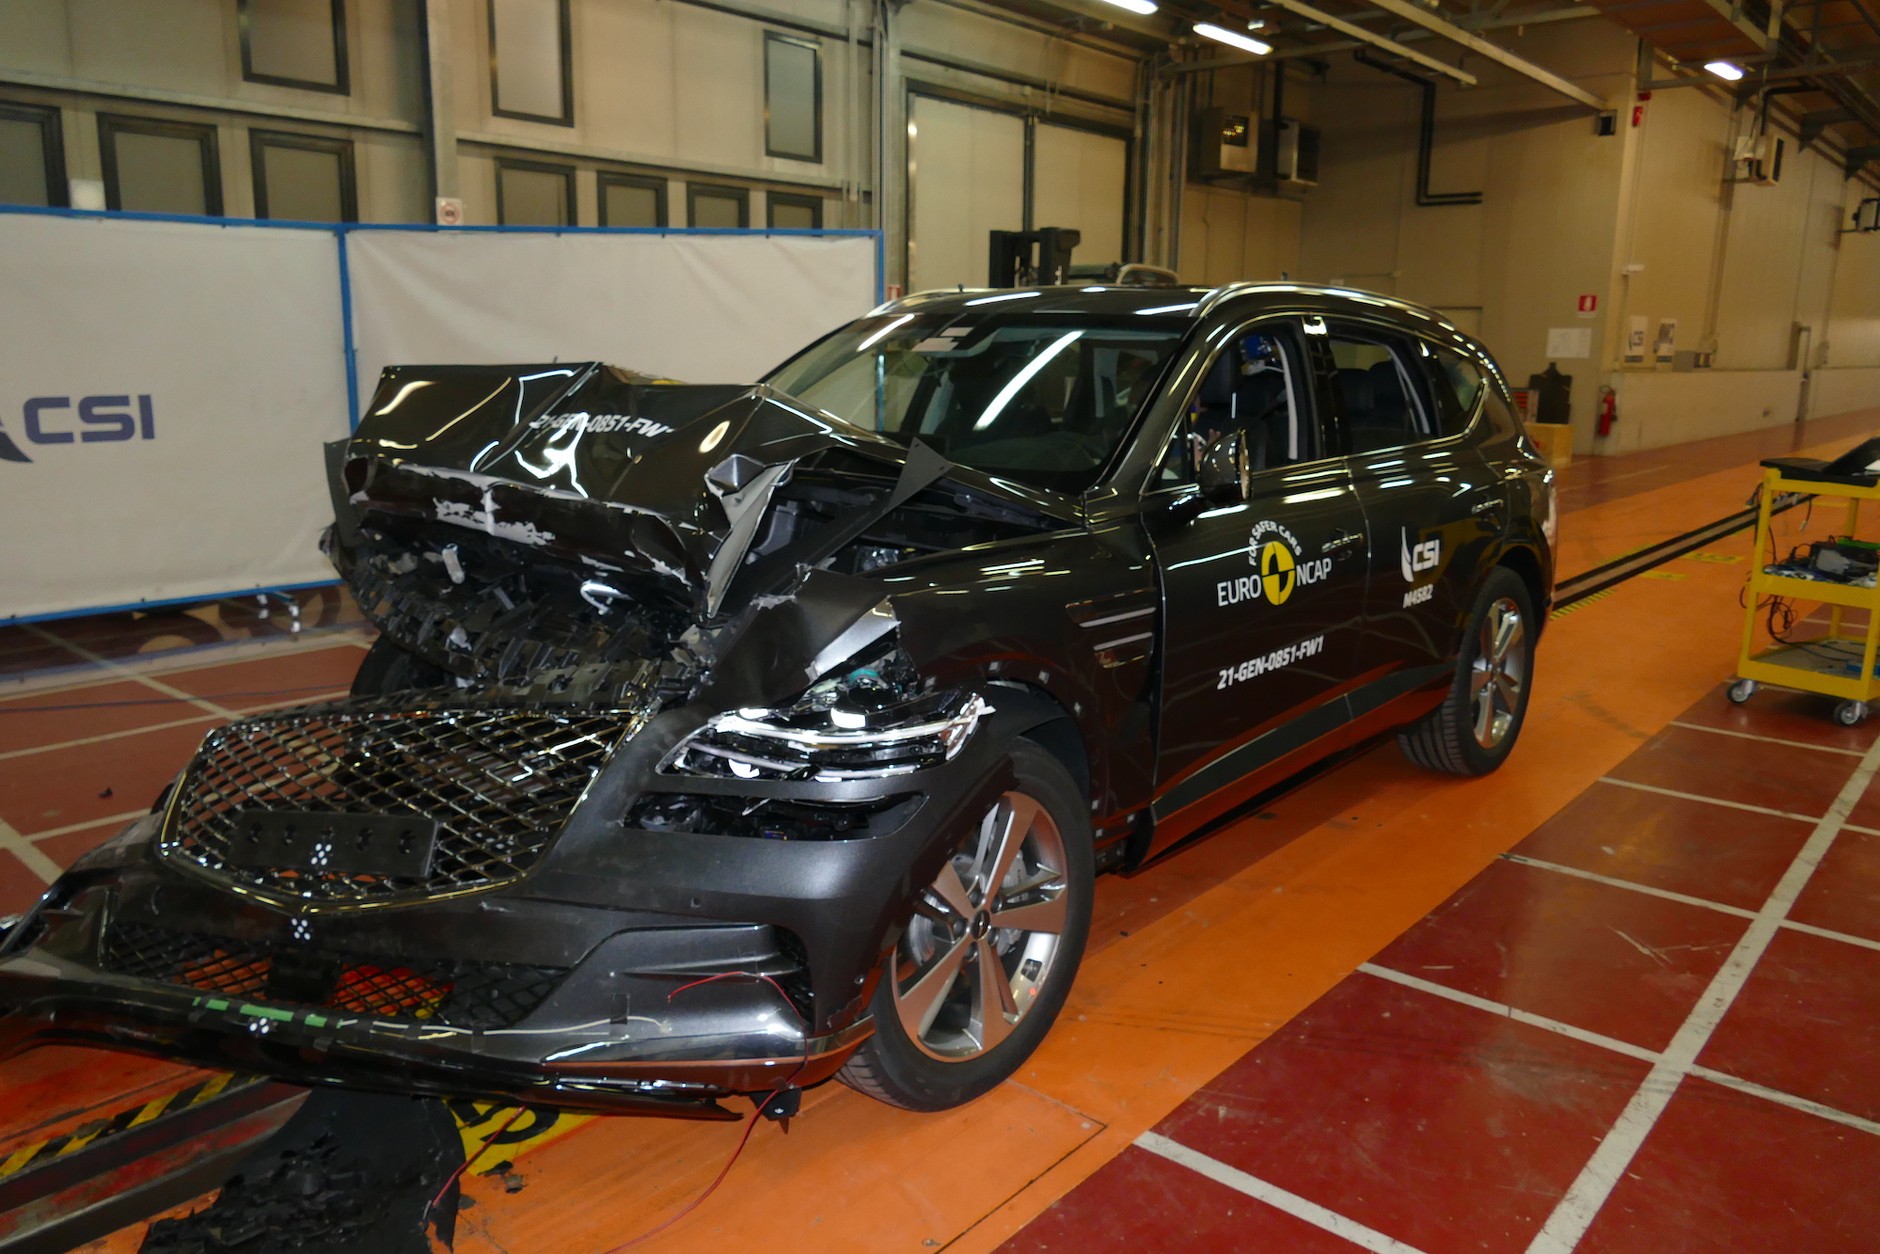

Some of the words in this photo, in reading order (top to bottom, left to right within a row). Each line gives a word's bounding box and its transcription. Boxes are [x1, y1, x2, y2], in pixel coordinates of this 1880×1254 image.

[23, 395, 155, 445] CSI
[1252, 520, 1278, 539] SAFER
[1279, 525, 1302, 556] CARS
[1249, 537, 1258, 566] FOR
[1412, 539, 1440, 572] CSI
[1217, 574, 1262, 607] EURO
[1296, 558, 1332, 587] NCAP
[1217, 635, 1324, 690] 21-GEN-0851-FW1
